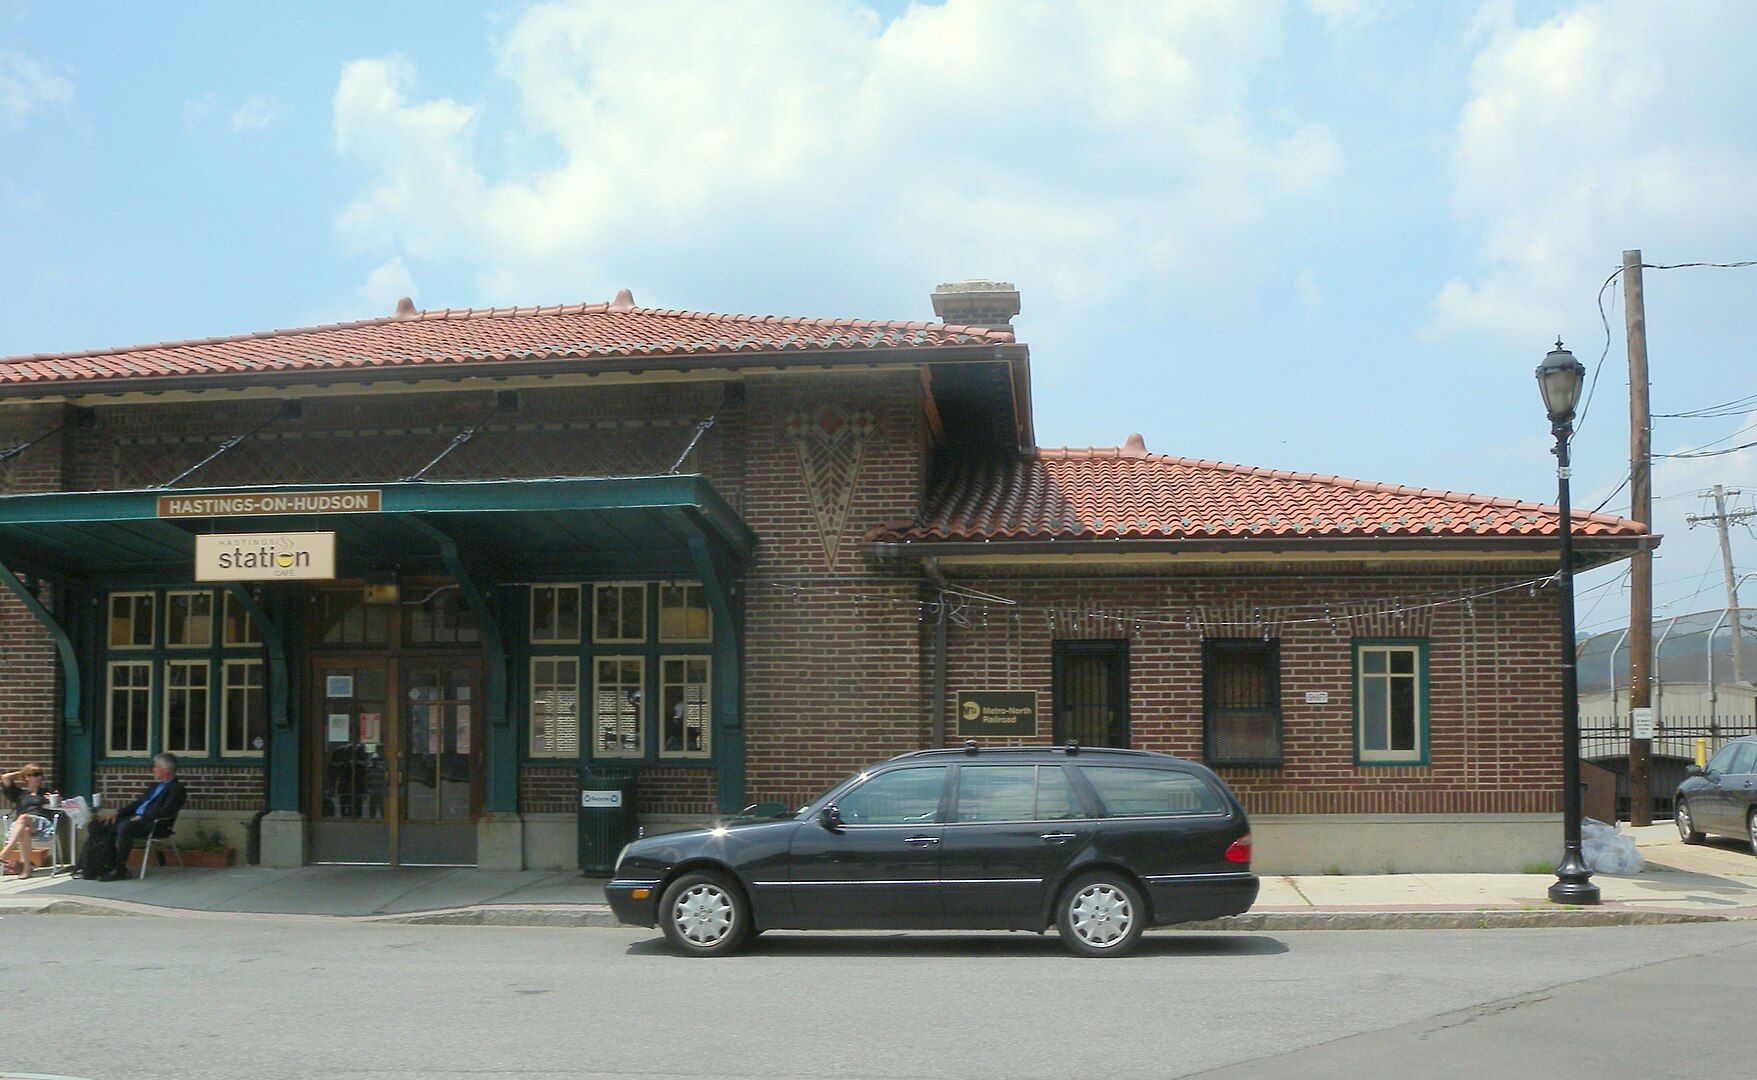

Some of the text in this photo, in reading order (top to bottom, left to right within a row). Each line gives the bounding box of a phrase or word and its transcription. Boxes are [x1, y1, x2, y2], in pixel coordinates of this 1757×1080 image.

[169, 495, 369, 514] HASTINGS-ON-HUDSON
[218, 538, 275, 547] HASTINGS
[983, 706, 1032, 715] Metro-North
[983, 716, 1017, 724] Railroad
